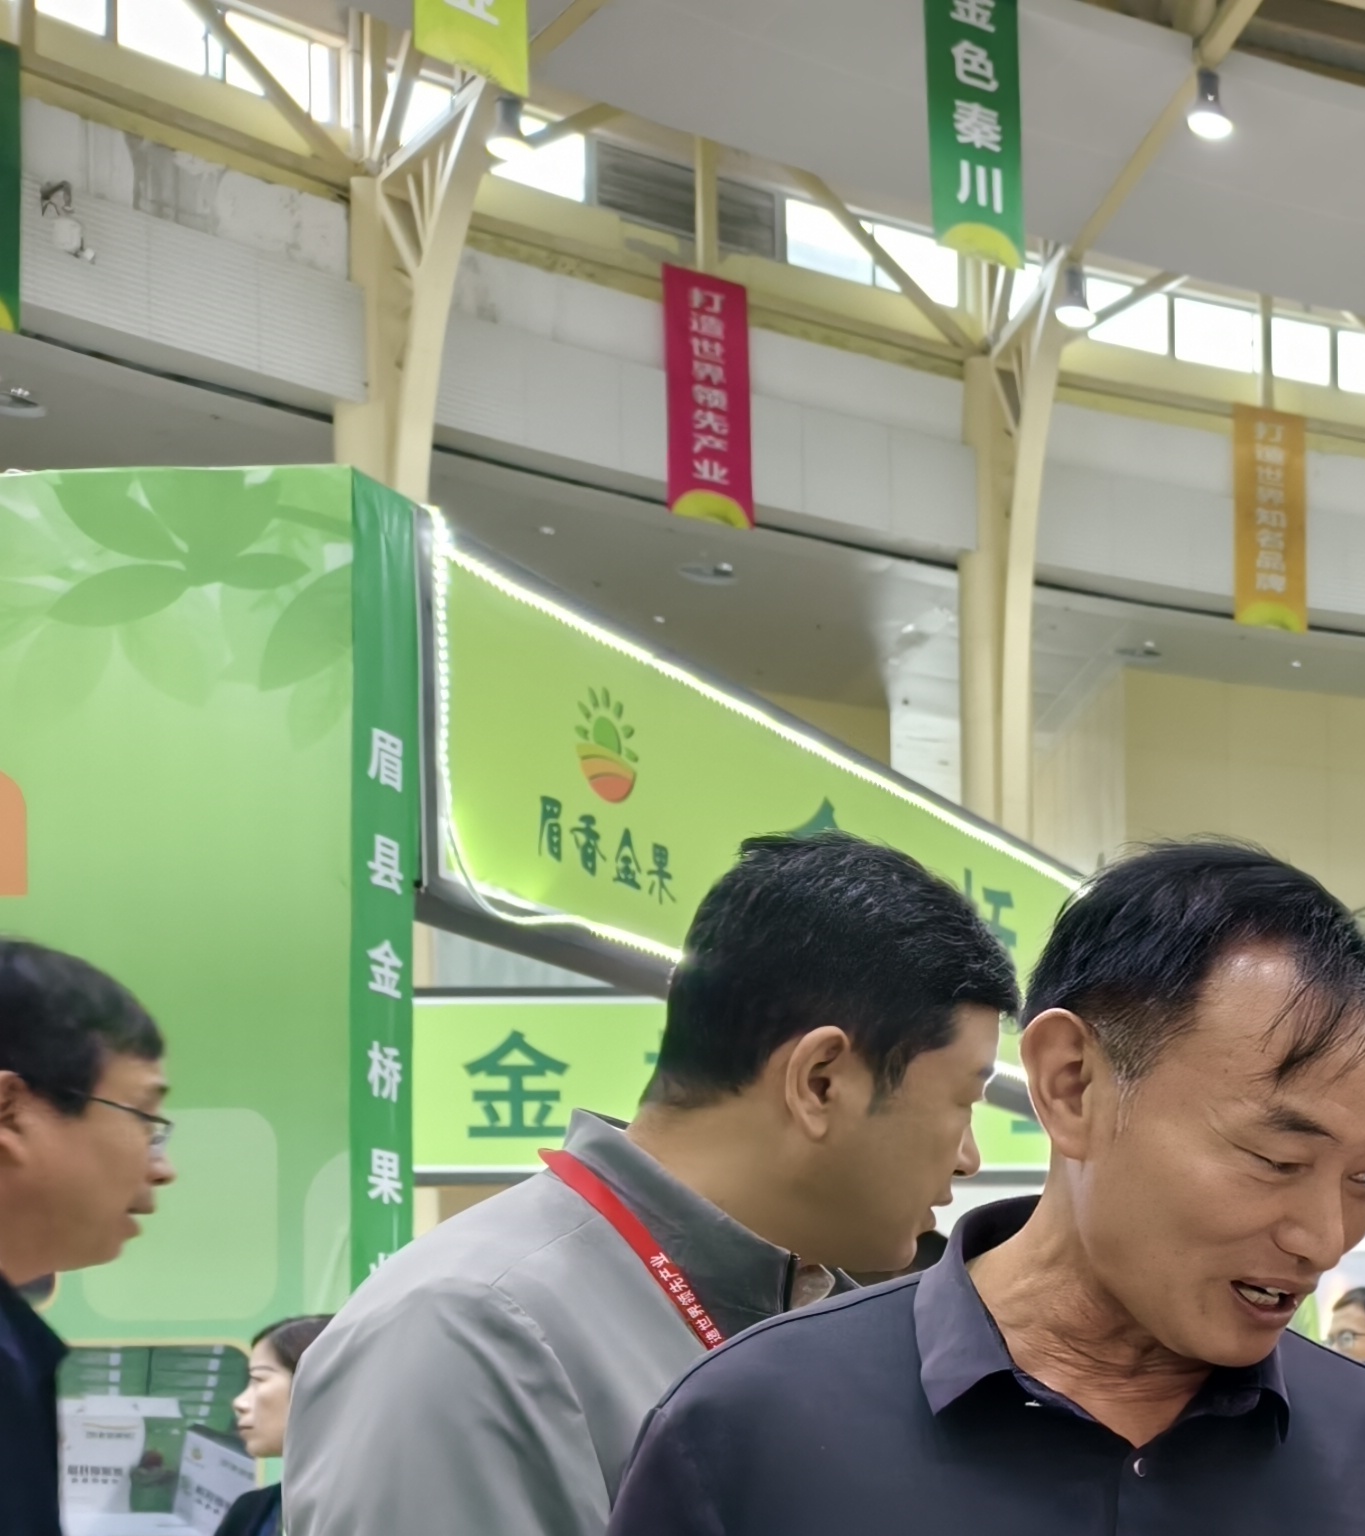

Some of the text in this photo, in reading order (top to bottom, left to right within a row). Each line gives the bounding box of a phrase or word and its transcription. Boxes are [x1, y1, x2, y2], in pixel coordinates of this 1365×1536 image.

[687, 284, 731, 486] 打造世界领先产业
[1253, 418, 1287, 595] 打造世界知名品牌
[537, 795, 676, 905] 眉香金果
